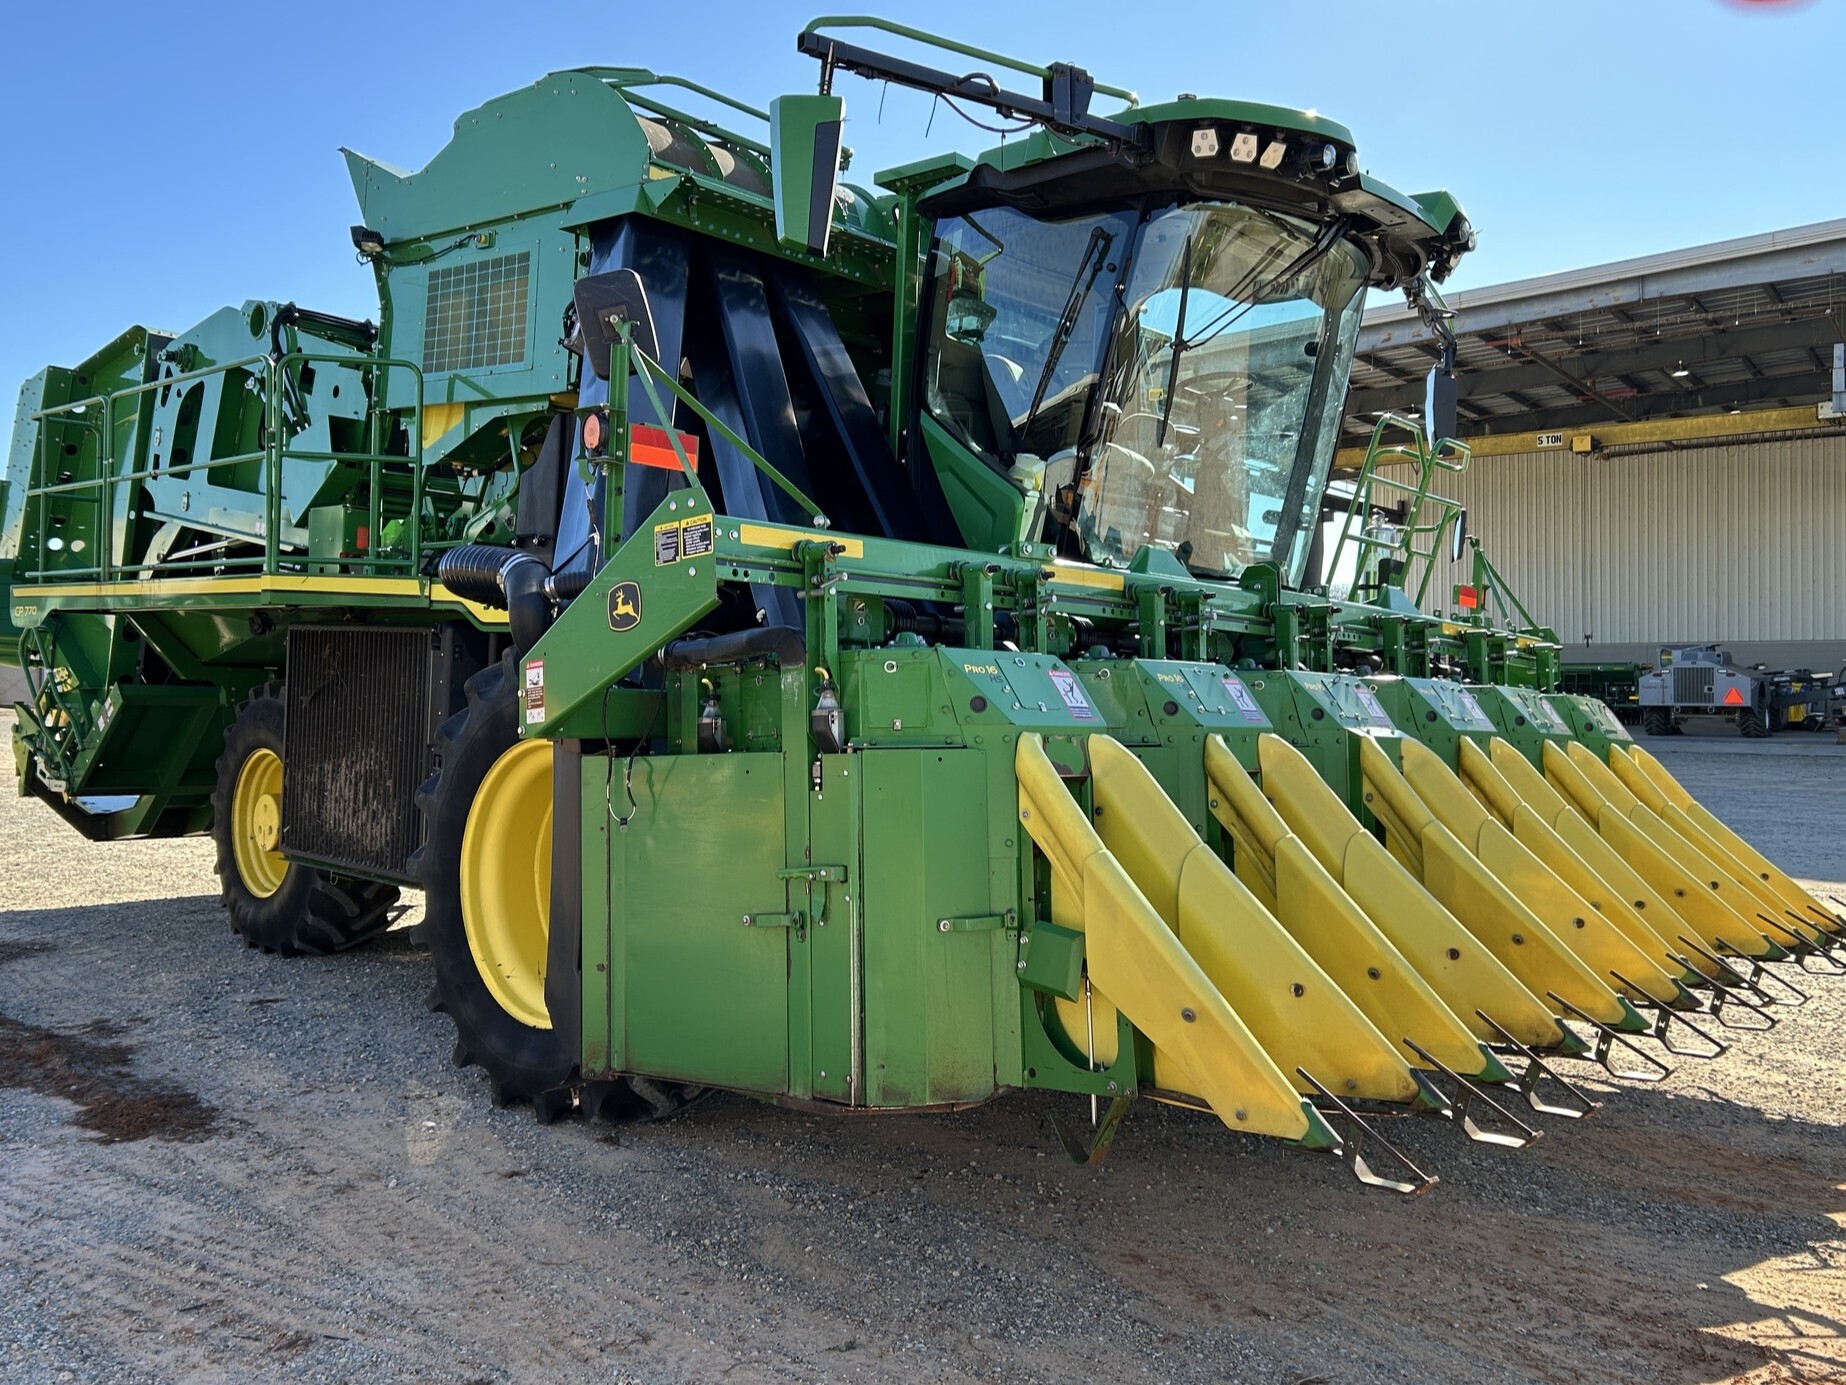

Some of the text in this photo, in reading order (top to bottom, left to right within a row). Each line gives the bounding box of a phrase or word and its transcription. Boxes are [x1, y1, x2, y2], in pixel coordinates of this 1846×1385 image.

[1537, 434, 1562, 446] 5 TON
[24, 605, 37, 617] 770
[985, 665, 998, 674] 16
